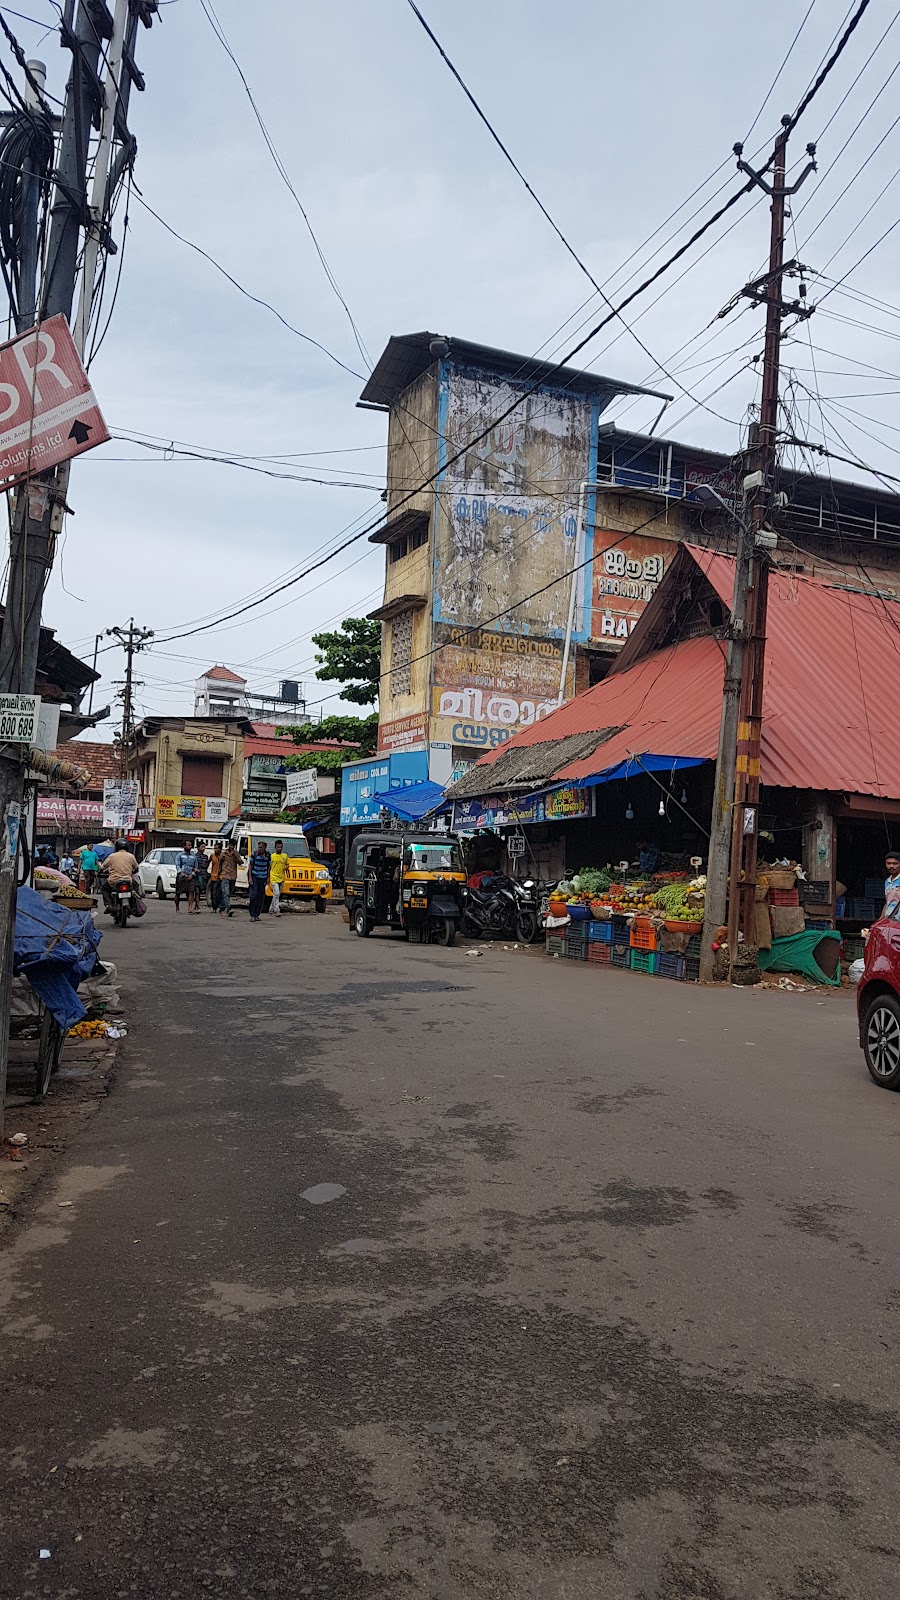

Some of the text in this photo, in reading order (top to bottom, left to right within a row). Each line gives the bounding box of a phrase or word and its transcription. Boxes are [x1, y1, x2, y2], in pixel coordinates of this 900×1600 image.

[60, 398, 90, 415] Internship
[46, 431, 63, 447] ltd
[1, 717, 34, 737] 800 689
[349, 769, 368, 782] milma
